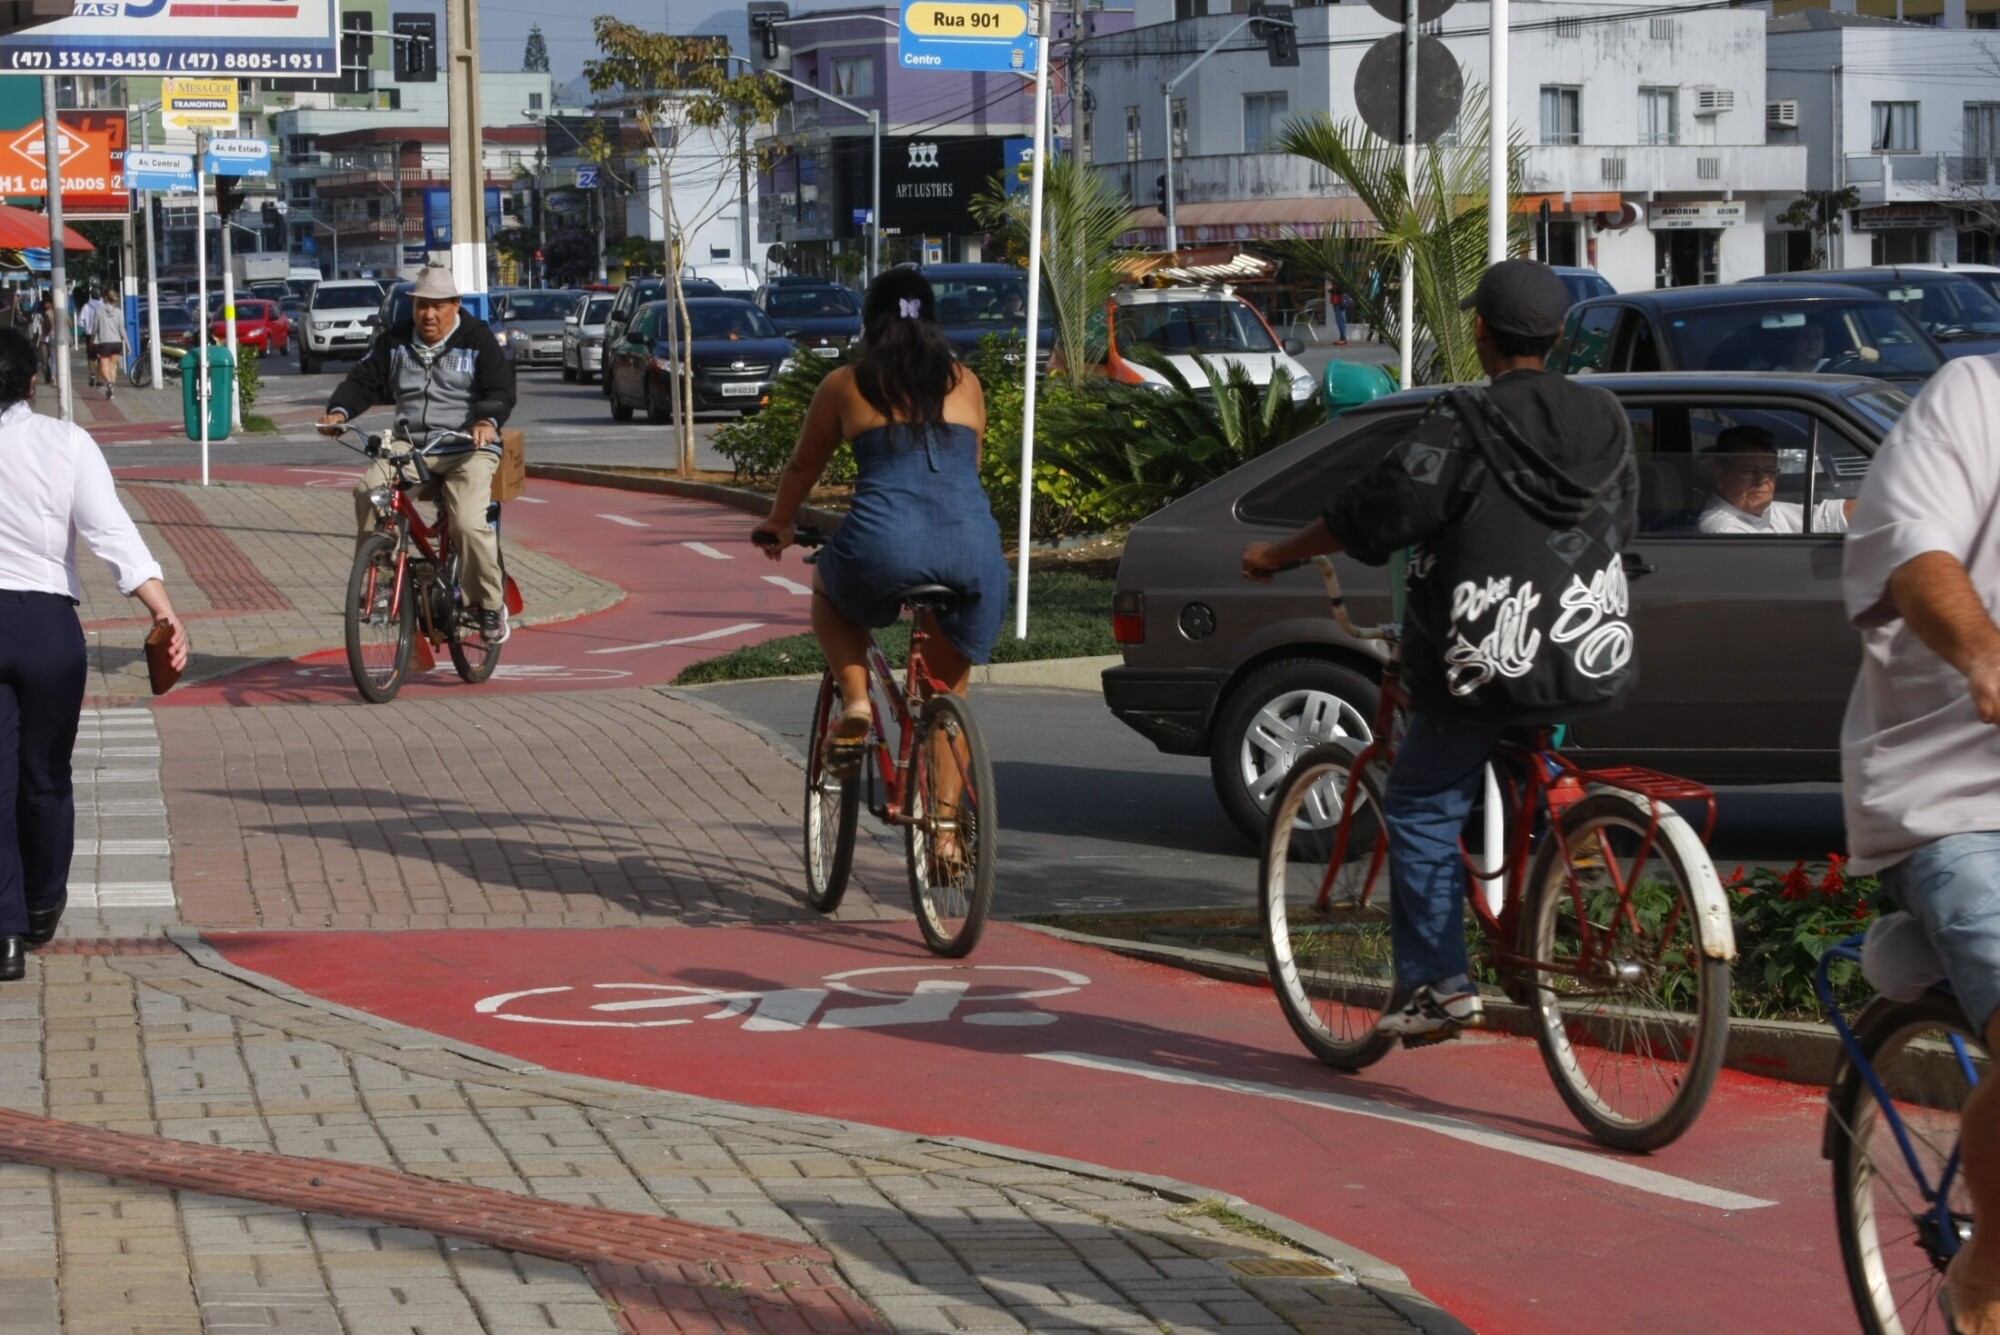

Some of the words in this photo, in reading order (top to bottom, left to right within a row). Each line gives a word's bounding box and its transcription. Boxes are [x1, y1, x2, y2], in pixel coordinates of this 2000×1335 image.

[934, 11, 965, 27] Rua
[971, 12, 999, 28] 901
[12, 51, 51, 69] (47)
[59, 52, 160, 67] 3367-8430
[179, 53, 218, 70] (47)
[224, 53, 323, 69] 8805-1931
[904, 53, 942, 65] Centro
[173, 100, 227, 109] TRAMONTINA
[215, 144, 226, 152] Av.
[228, 144, 236, 152] do
[238, 144, 262, 153] Estado
[138, 158, 150, 167] Av.
[152, 159, 180, 168] Central
[171, 183, 193, 191] Centro
[896, 184, 912, 198] ART
[915, 183, 953, 197] LUSTRES
